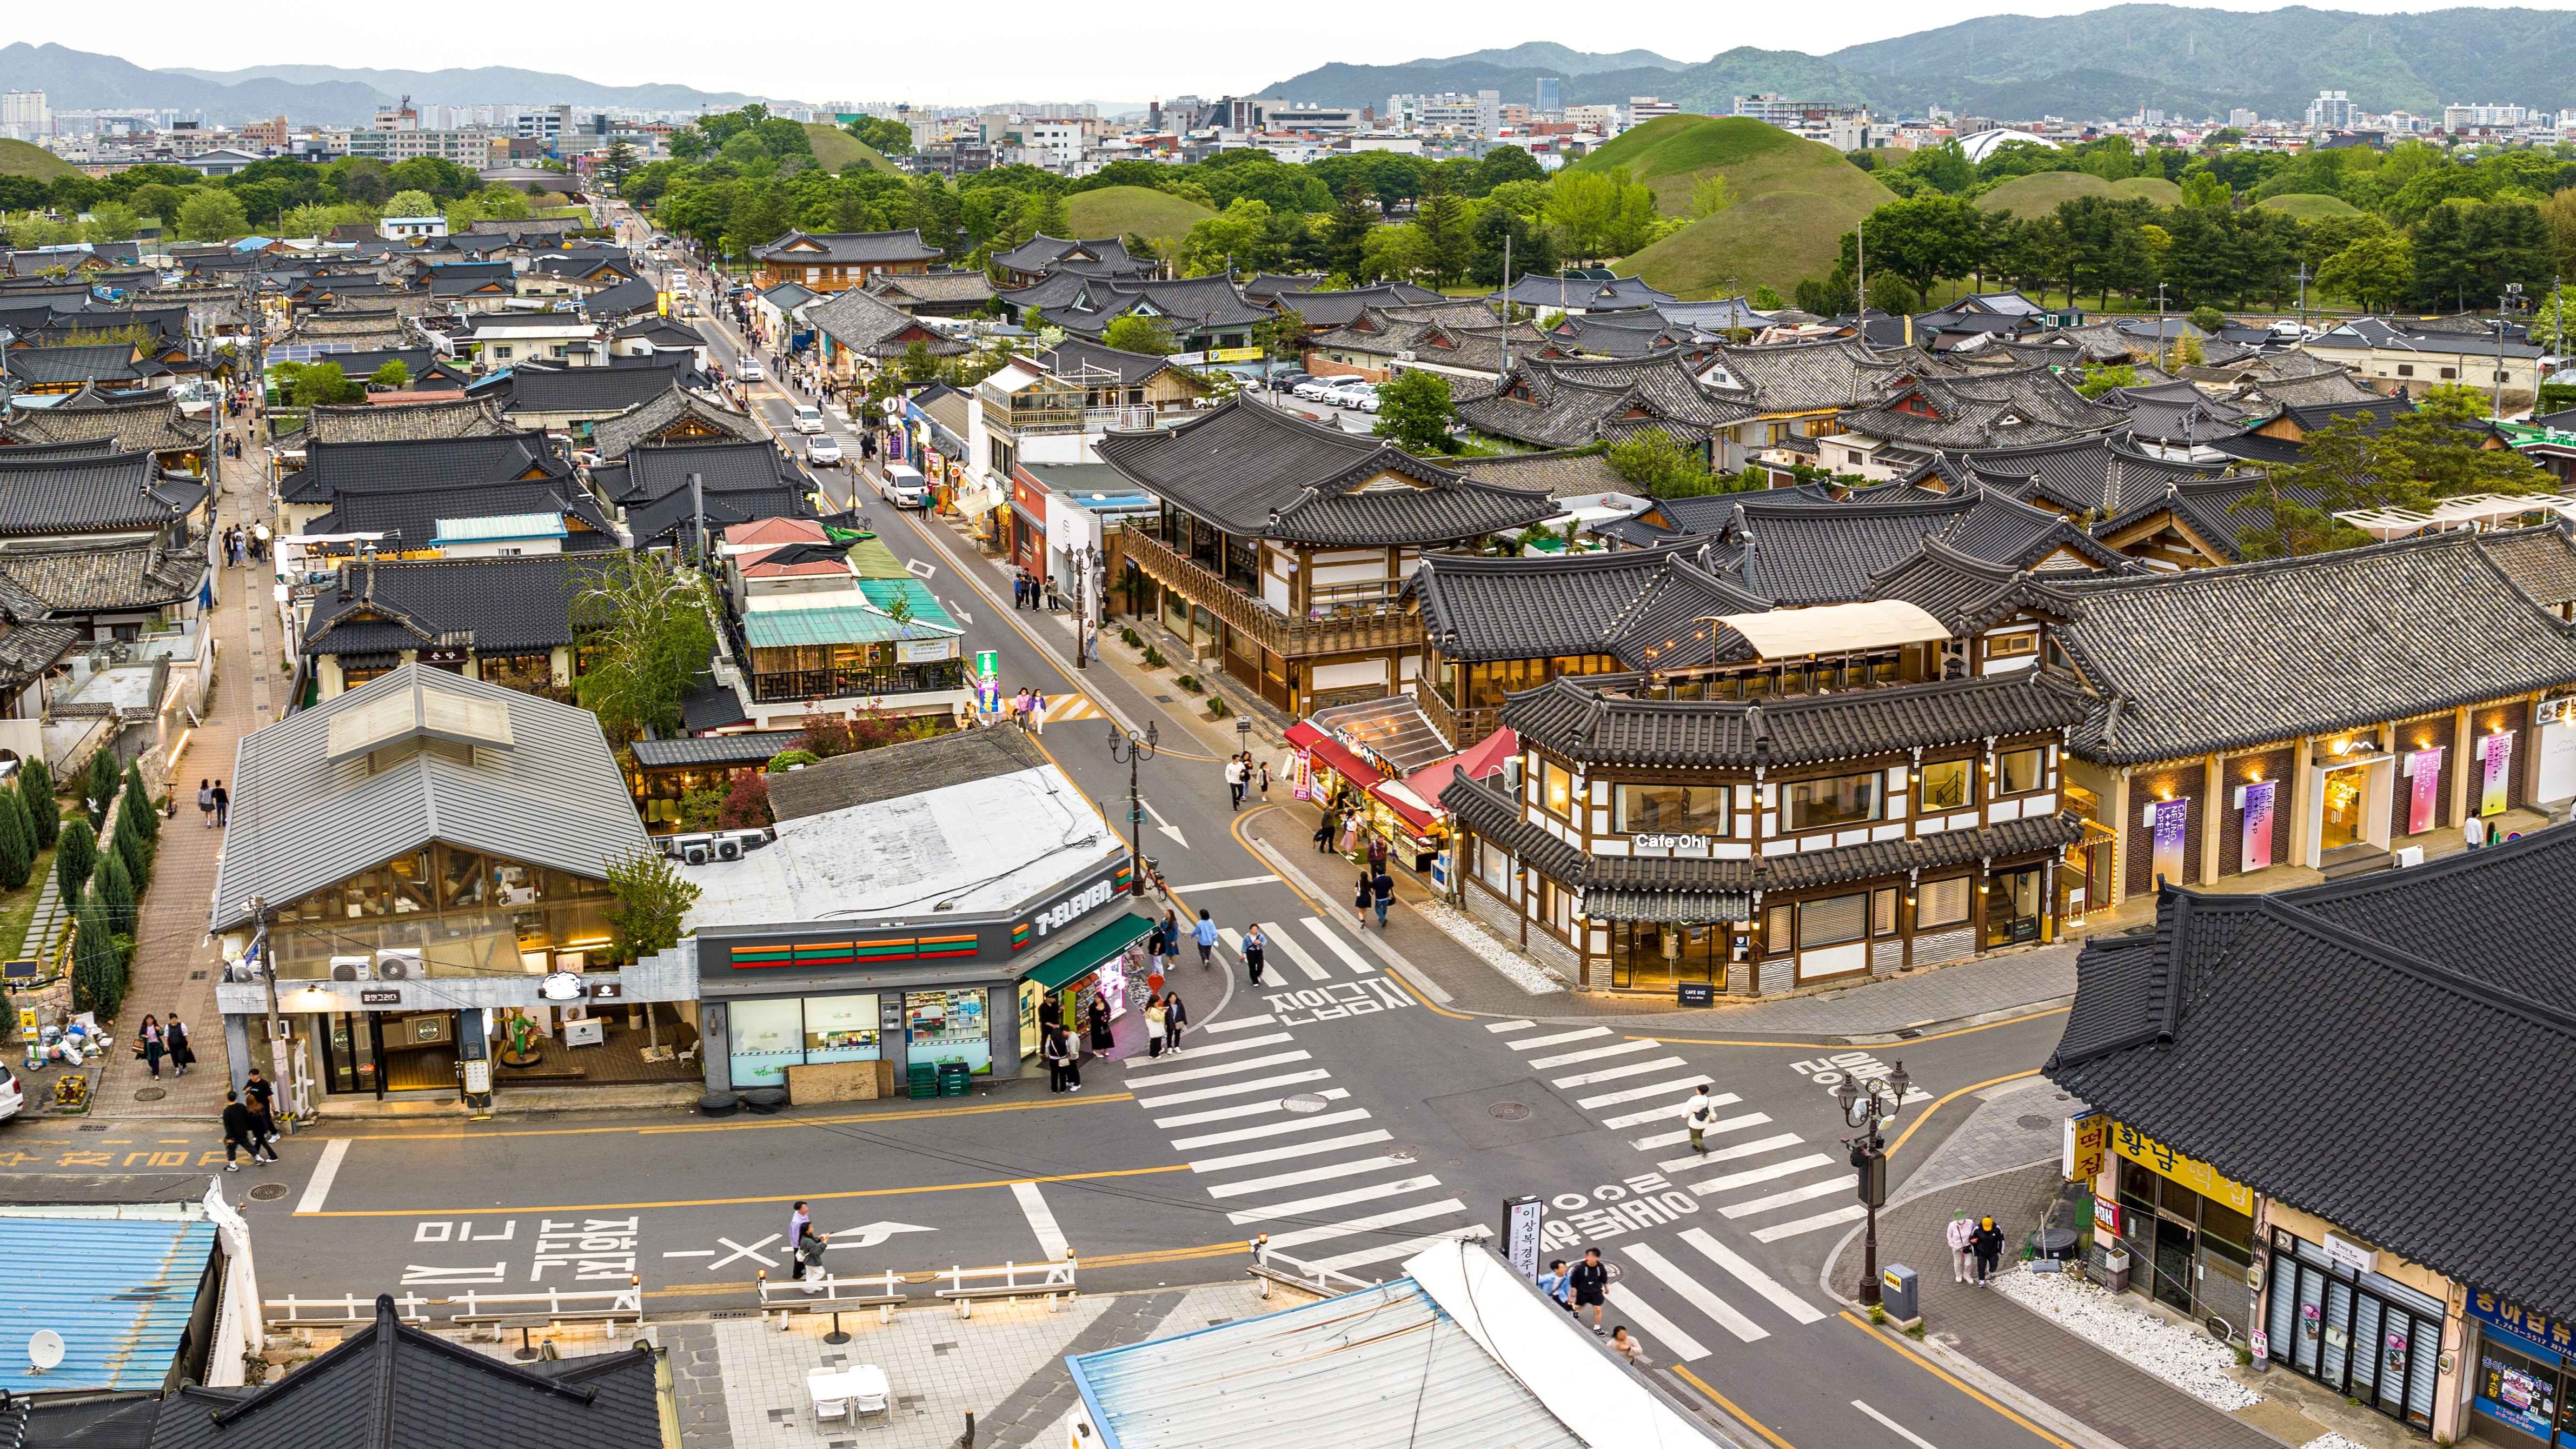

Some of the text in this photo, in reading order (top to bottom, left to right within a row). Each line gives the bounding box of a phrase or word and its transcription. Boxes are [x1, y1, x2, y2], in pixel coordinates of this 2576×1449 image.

[1636, 834, 1706, 848] Cafe Ohi
[1261, 976, 1418, 1026] 진입금지
[2079, 1116, 2104, 1131] 황남
[2079, 1128, 2102, 1175] 떡집
[400, 1220, 516, 1285] 금지
[530, 1216, 639, 1281] 좌회전
[2482, 1355, 2502, 1373] 동아
[2488, 1372, 2500, 1398] 무스탕
